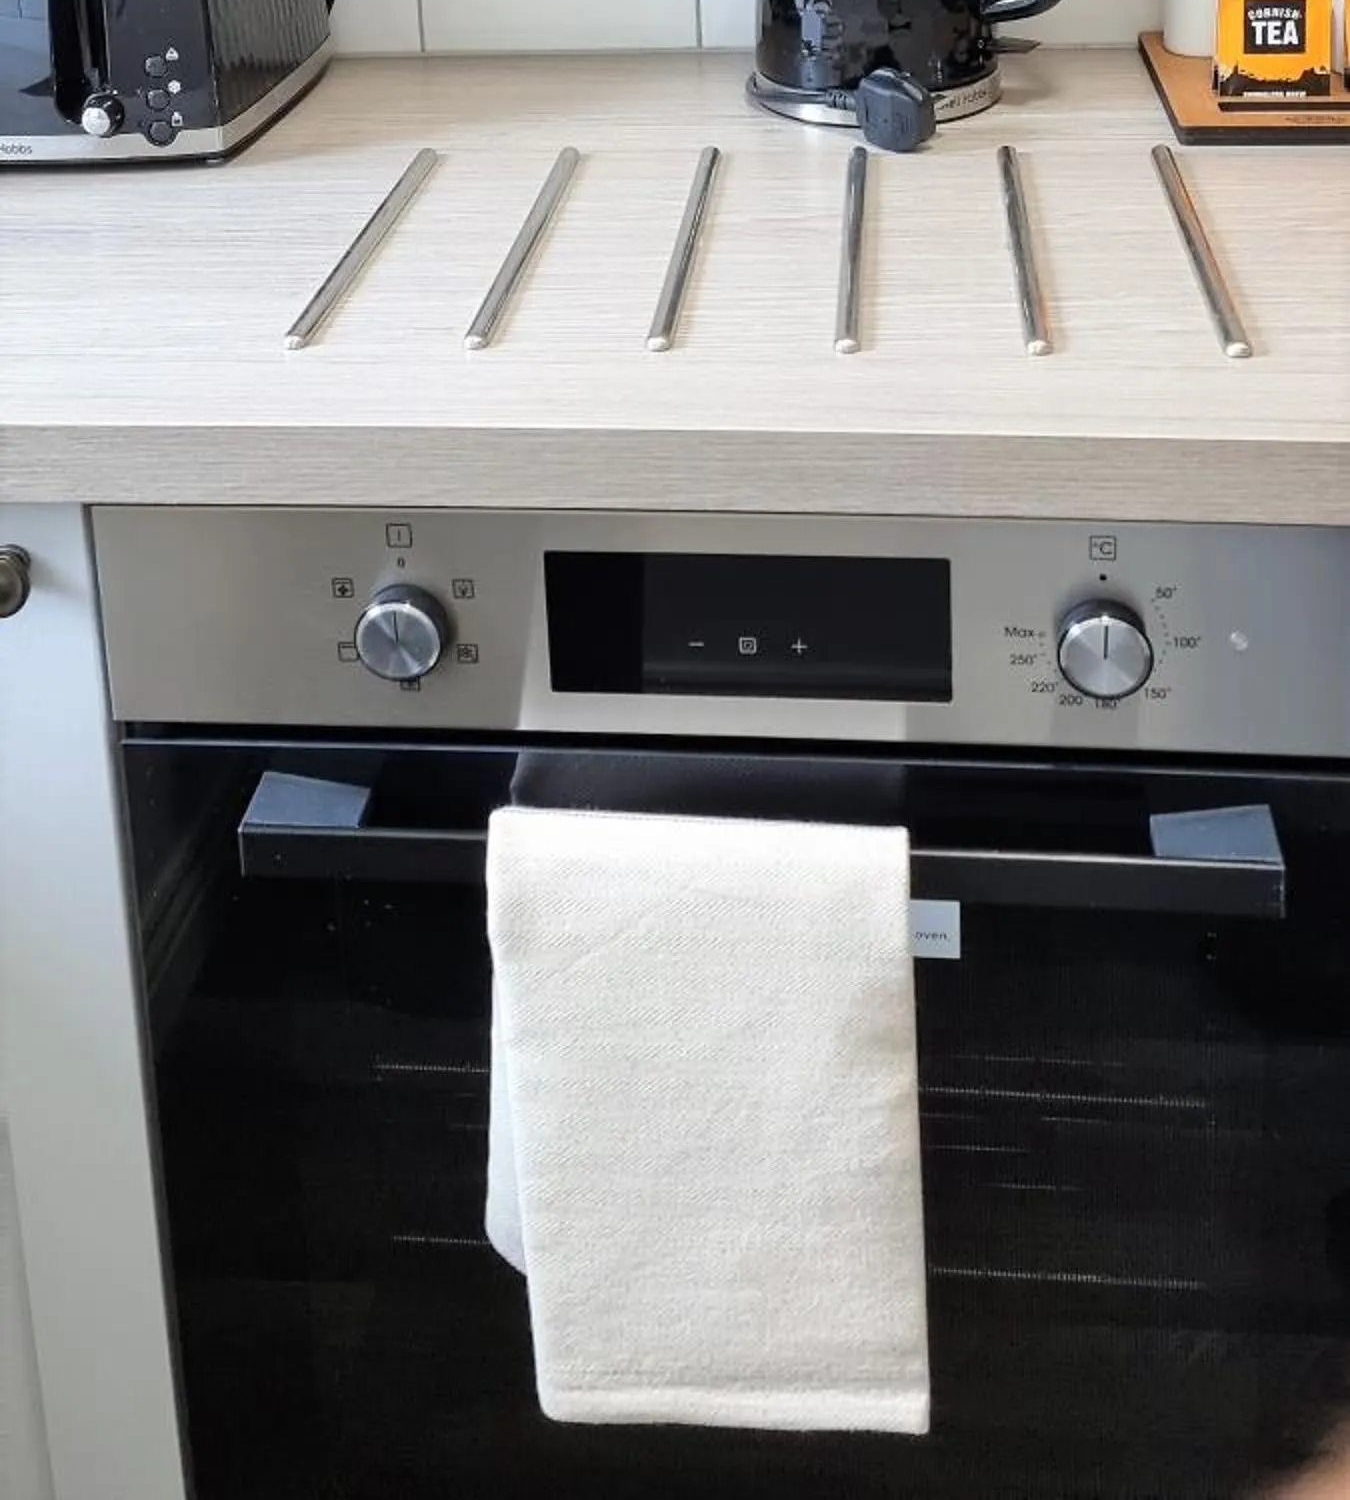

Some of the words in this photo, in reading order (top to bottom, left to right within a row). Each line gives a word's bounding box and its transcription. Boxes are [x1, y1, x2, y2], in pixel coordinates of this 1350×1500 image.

[1247, 7, 1303, 21] CORNISH
[1251, 20, 1299, 46] TEA
[1004, 626, 1035, 638] Max
